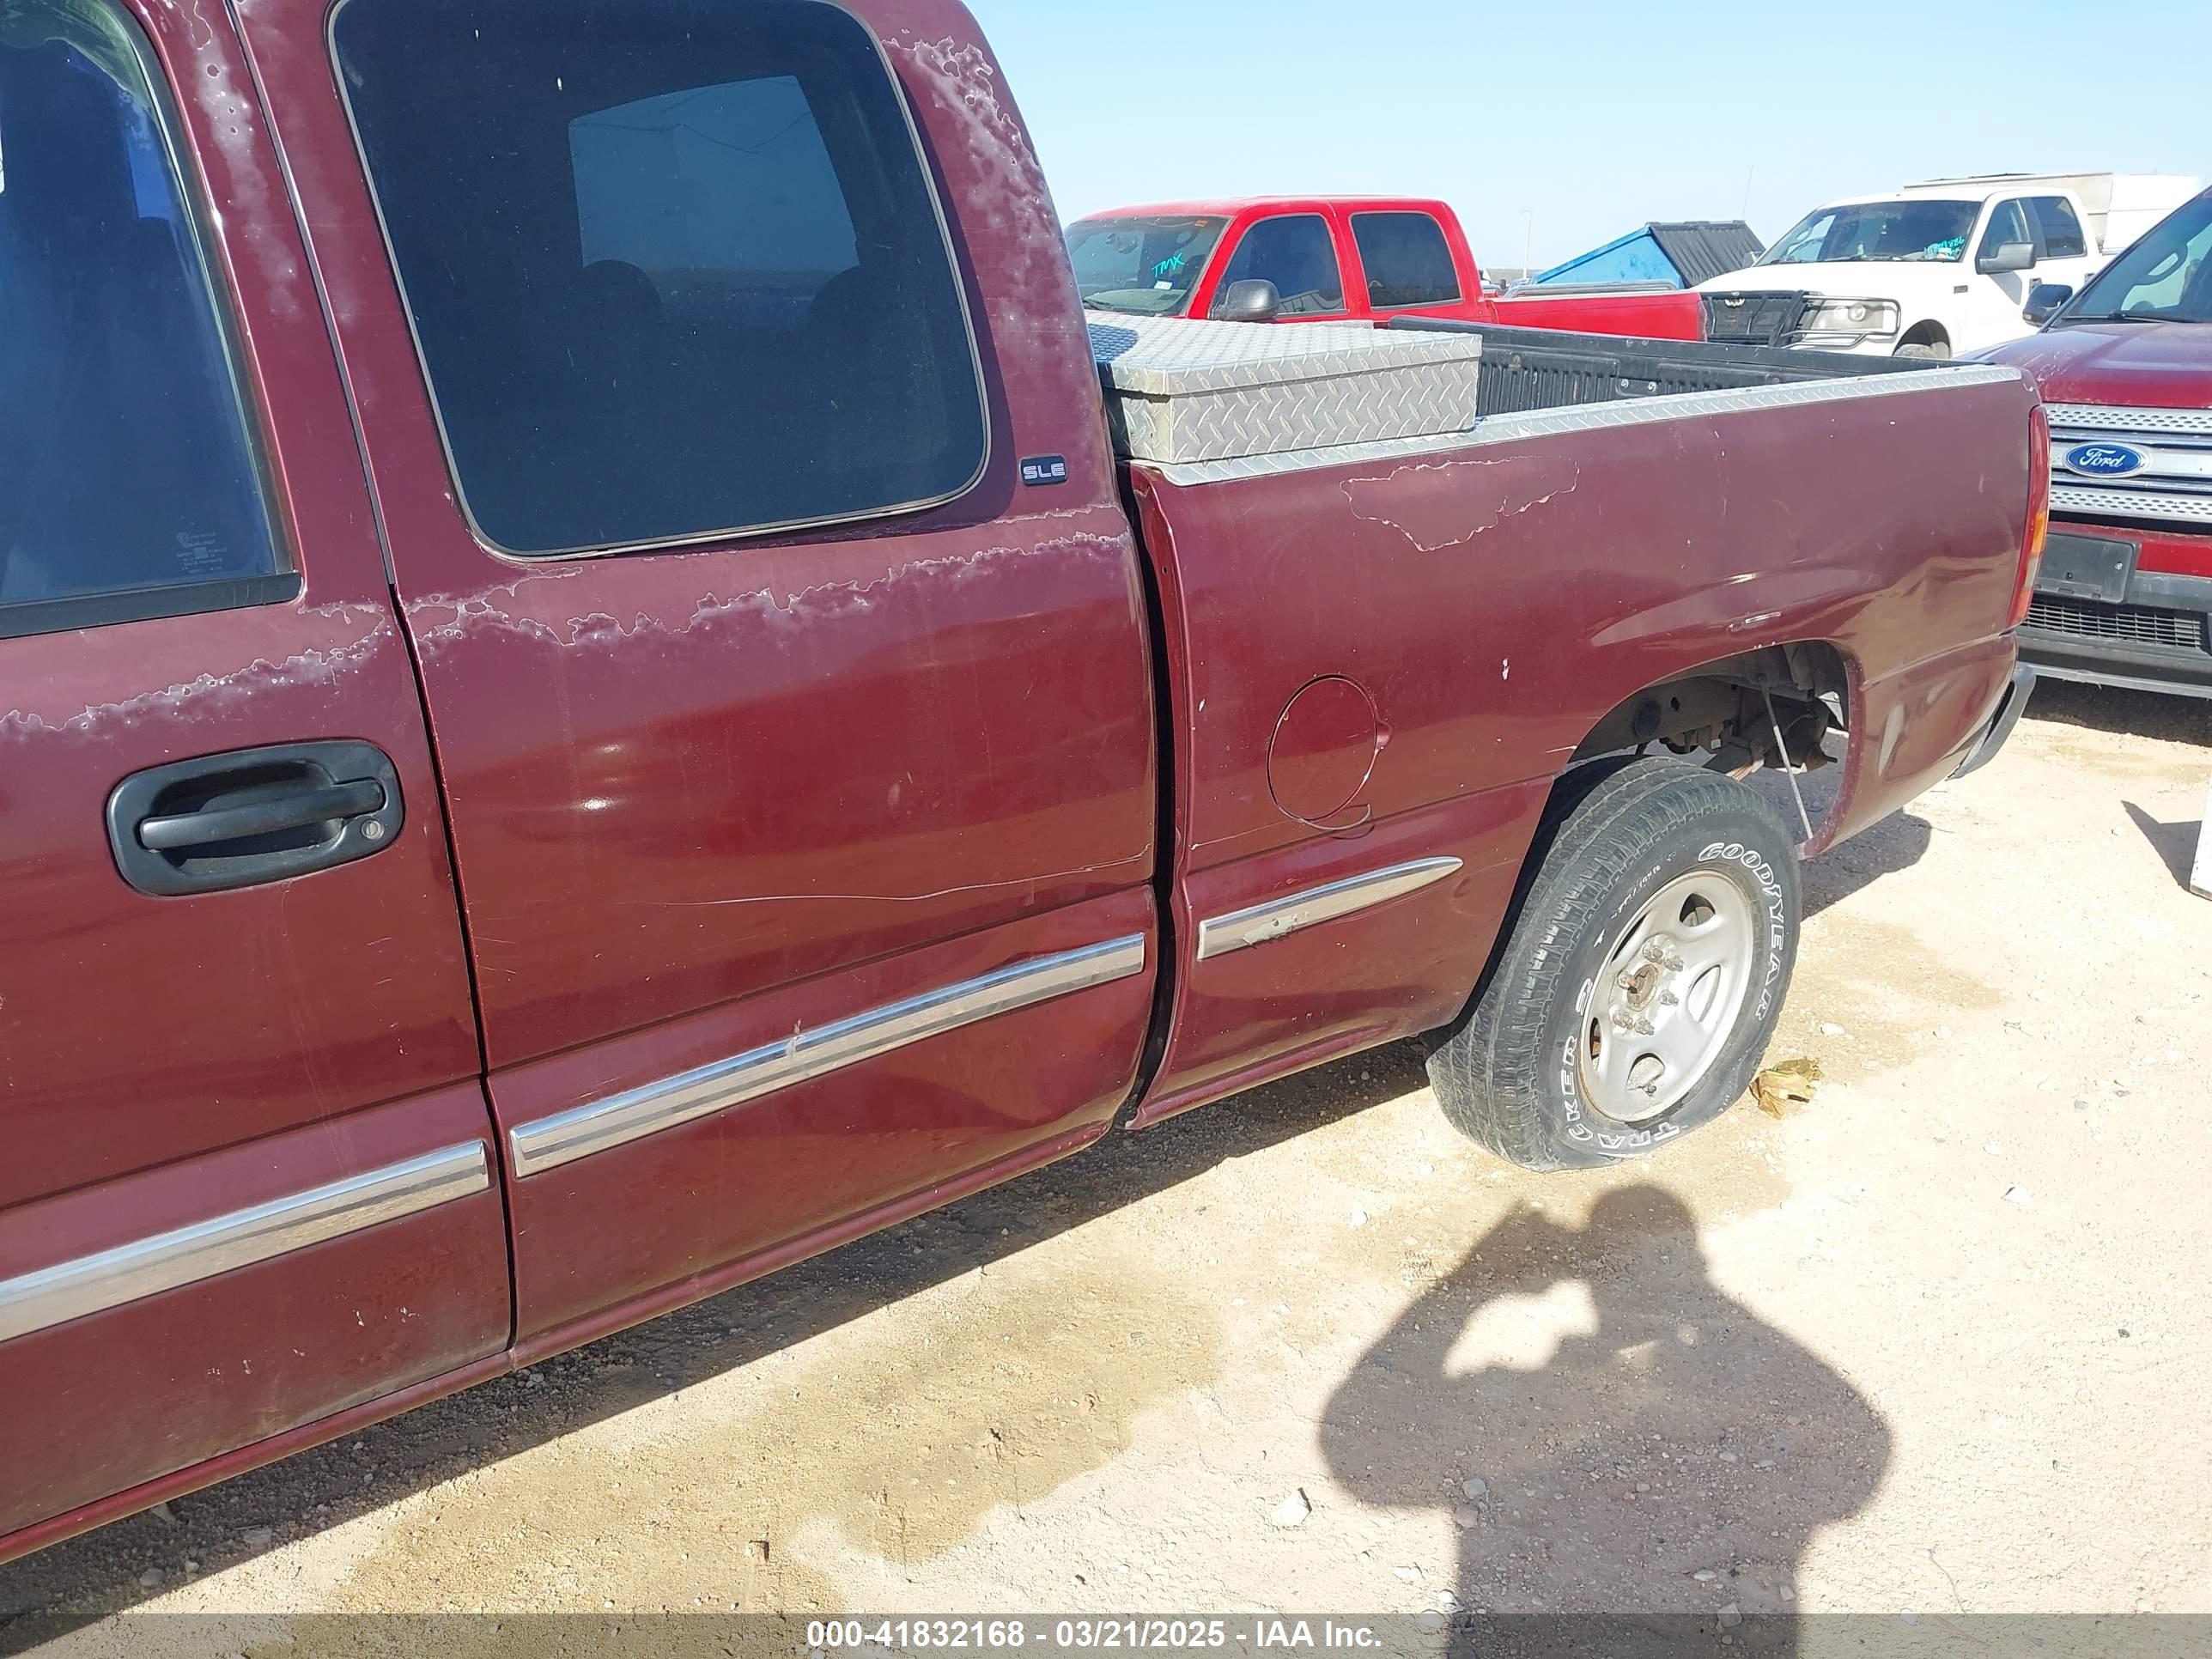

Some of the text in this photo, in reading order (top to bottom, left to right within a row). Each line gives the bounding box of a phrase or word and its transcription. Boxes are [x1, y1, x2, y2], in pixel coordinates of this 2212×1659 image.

[1023, 463, 1066, 480] SLE
[2079, 447, 2127, 468] Ford
[1698, 842, 1784, 1021] GOODYEAR
[1561, 1036, 1680, 1149] TRACKER
